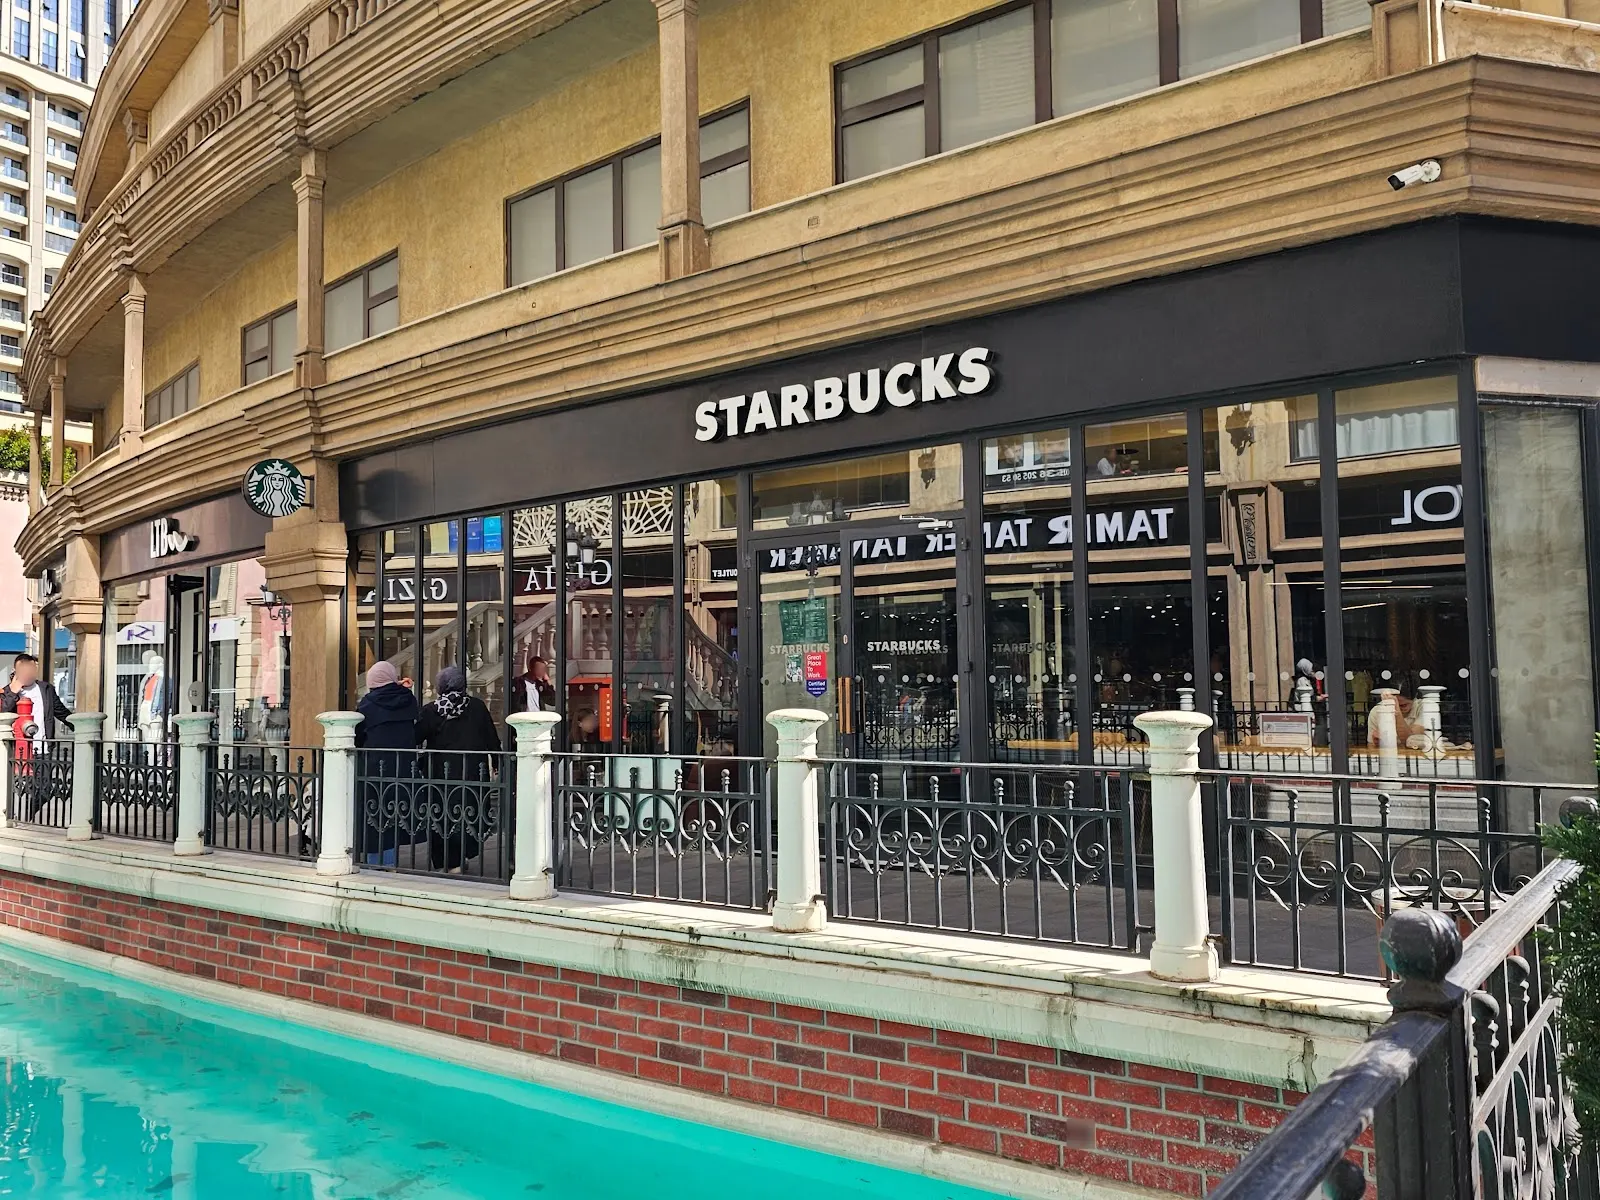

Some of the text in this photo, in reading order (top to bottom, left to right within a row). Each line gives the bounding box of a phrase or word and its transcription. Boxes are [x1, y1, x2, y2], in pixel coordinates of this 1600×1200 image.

[694, 347, 992, 442] STARBUCKS
[769, 643, 830, 655] STARBUCKS
[867, 639, 941, 652] STARBUCKS
